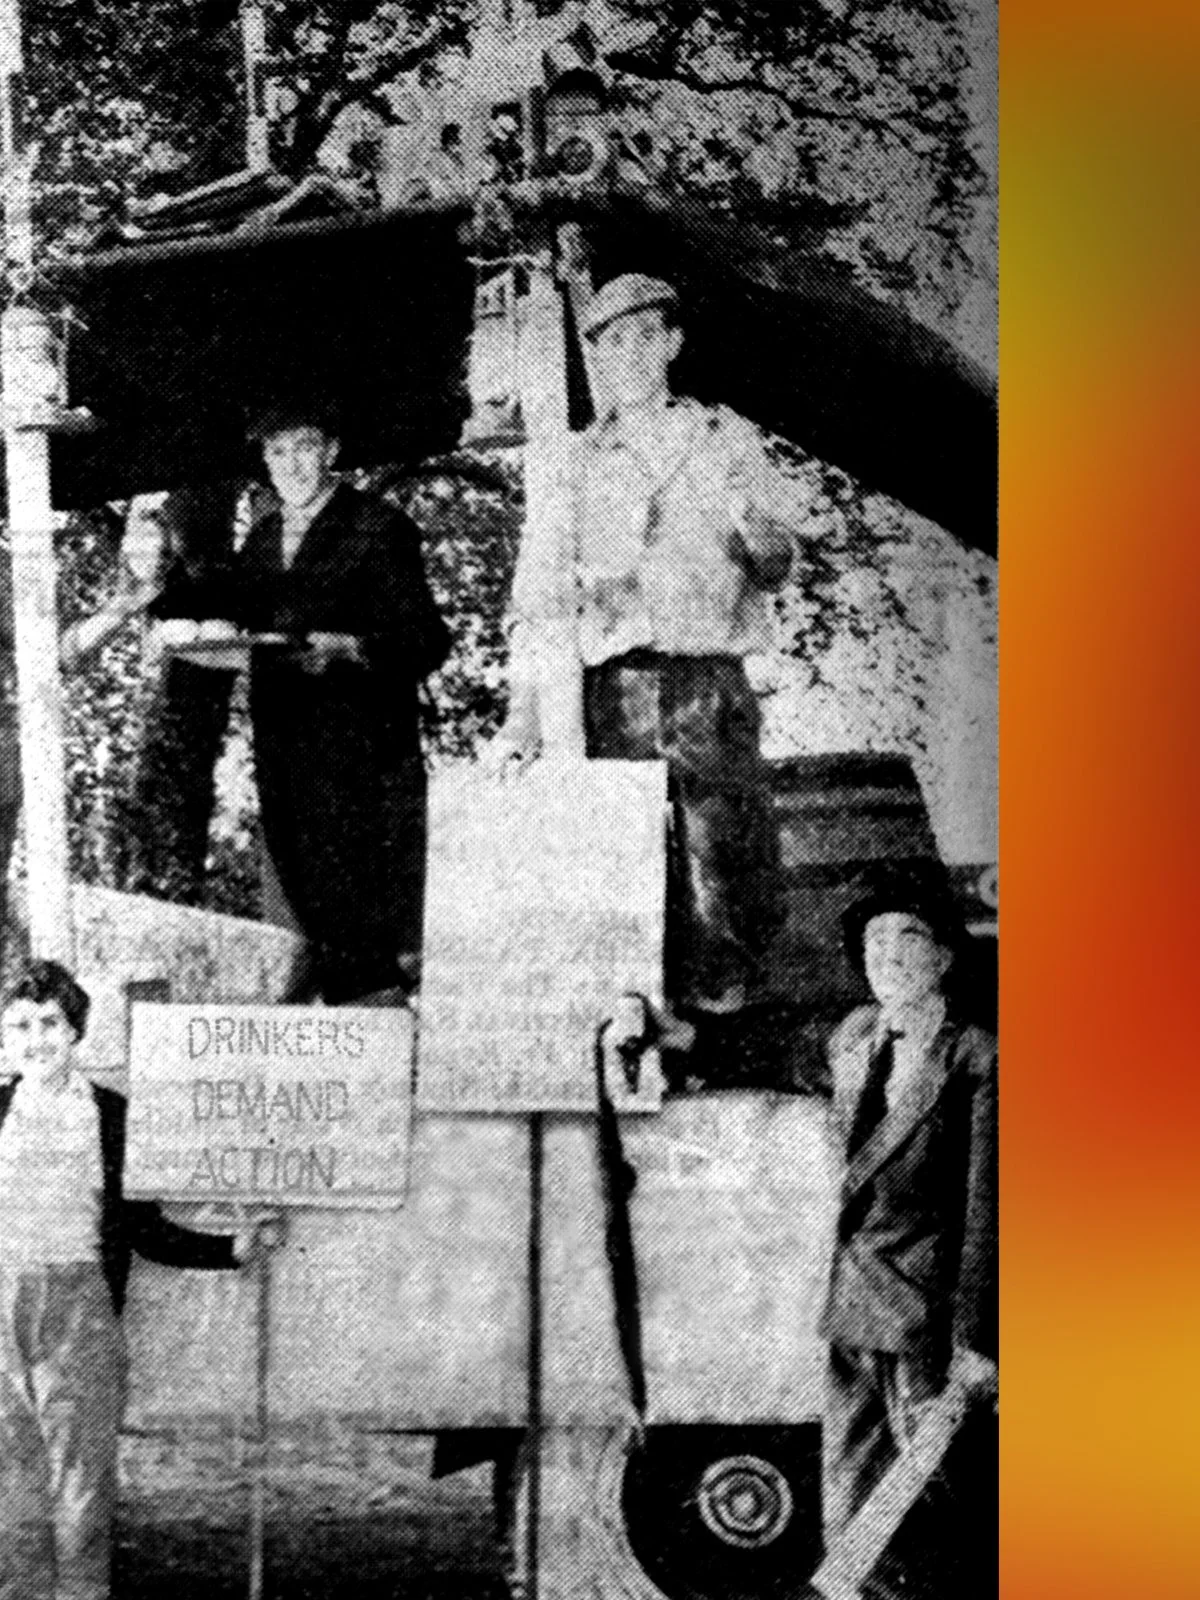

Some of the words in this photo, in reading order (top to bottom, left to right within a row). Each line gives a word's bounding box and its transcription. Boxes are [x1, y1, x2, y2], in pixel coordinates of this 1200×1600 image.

[188, 1016, 365, 1060] DRINKERS
[192, 1078, 350, 1123] DEMAND
[185, 1145, 336, 1189] ACTION
